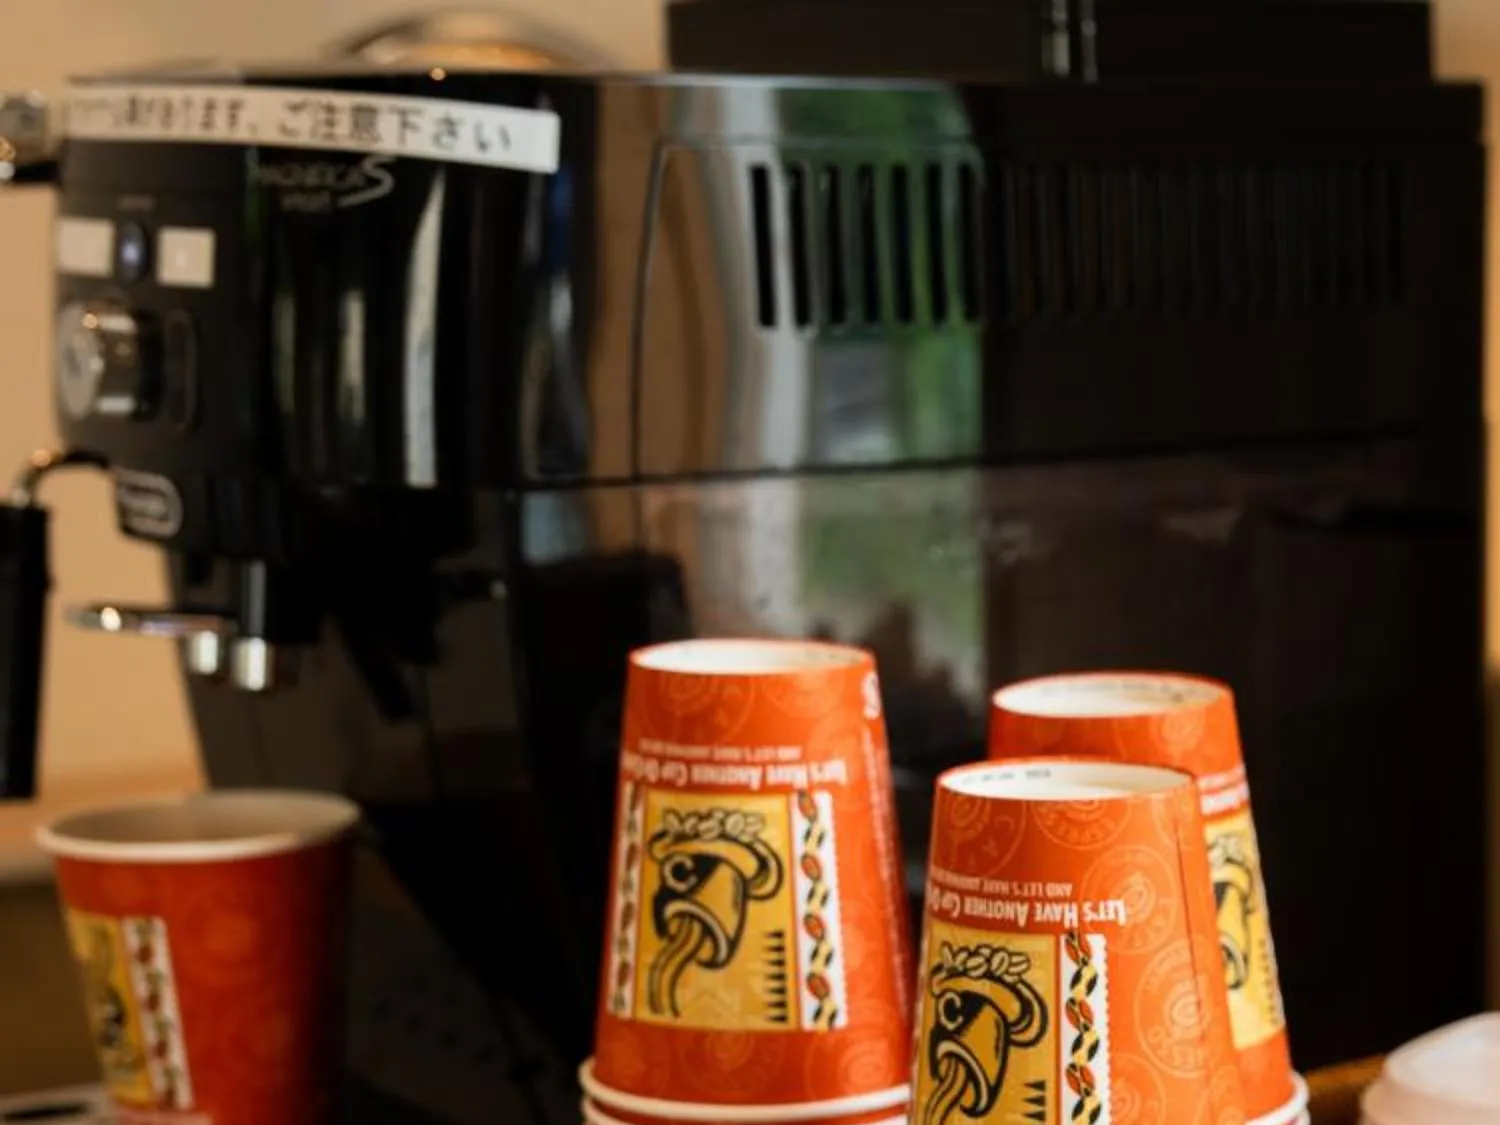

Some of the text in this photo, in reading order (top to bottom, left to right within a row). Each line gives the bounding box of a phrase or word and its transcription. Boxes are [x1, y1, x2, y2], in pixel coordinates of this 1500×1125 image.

[963, 896, 1029, 928] ANOTHER
[1034, 900, 1079, 929] HAVE
[1081, 899, 1127, 925] LET'S
